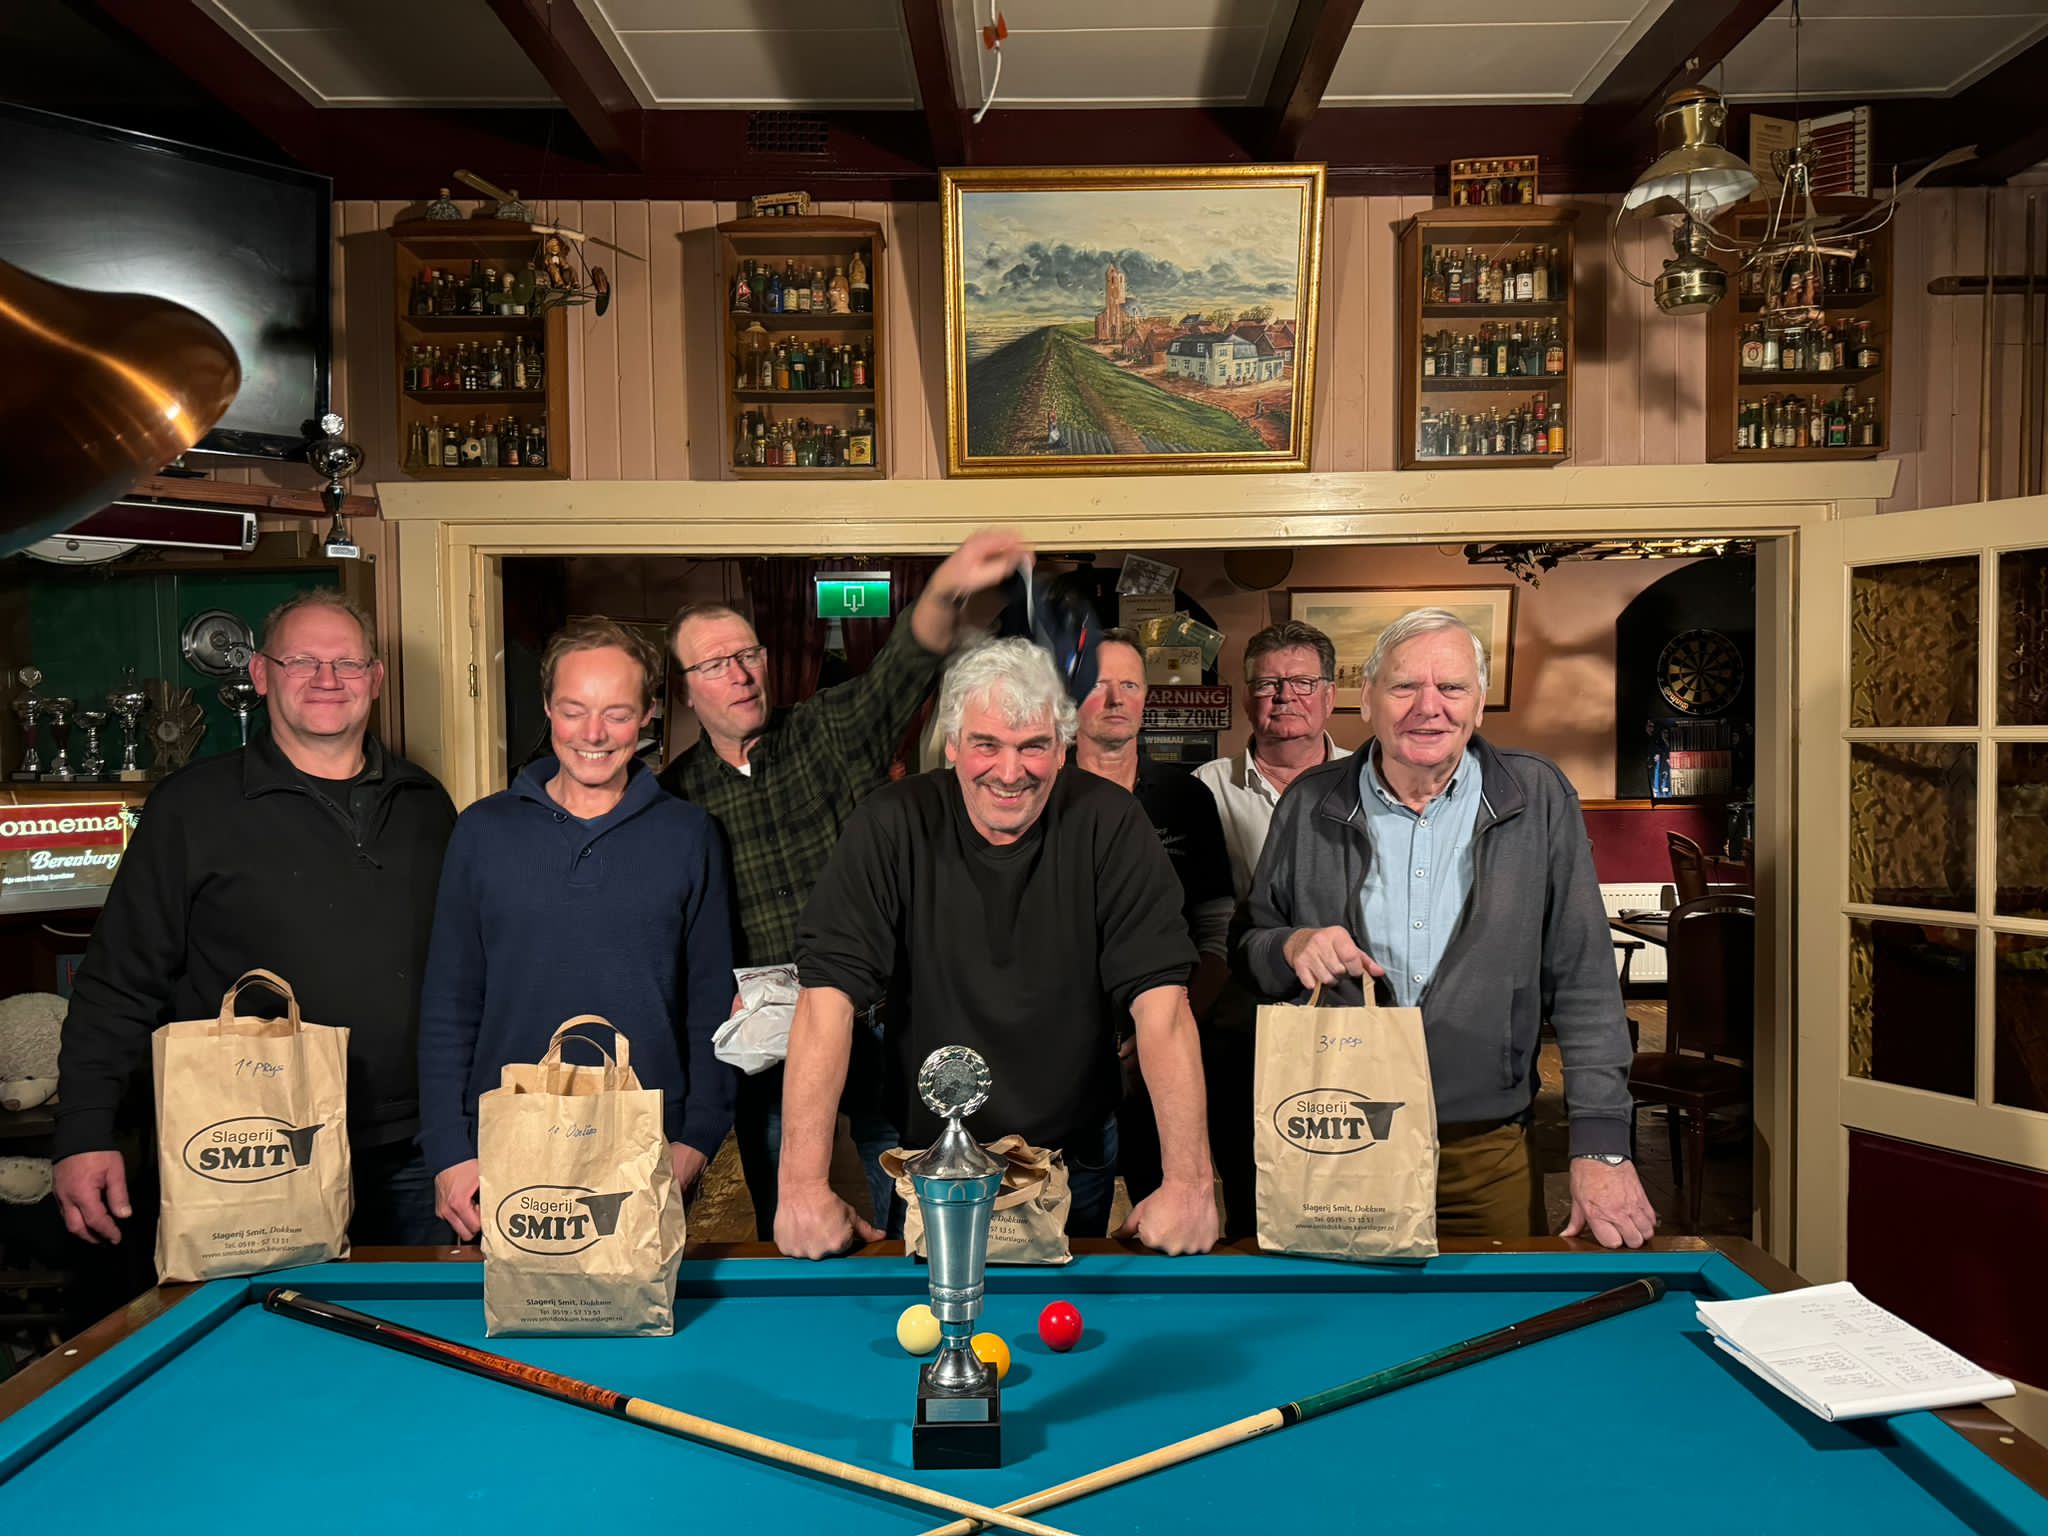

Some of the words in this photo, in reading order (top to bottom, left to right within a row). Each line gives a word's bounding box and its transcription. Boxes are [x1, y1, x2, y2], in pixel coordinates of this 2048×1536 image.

[1147, 689, 1226, 704] ARNING
[1184, 708, 1229, 727] ZONE
[0, 815, 123, 837] onnema
[30, 849, 121, 870] Berenburg
[1296, 1100, 1348, 1115] Slagerij
[211, 1128, 274, 1144] Slagerij
[1287, 1116, 1365, 1140] SMIT
[199, 1144, 290, 1171] SMIT
[520, 1196, 574, 1215] Slagerij
[1303, 1203, 1331, 1213] Slagerij
[212, 1231, 245, 1241] Slagerij
[508, 1213, 590, 1241] SMIT
[526, 1298, 556, 1307] Slagerij
